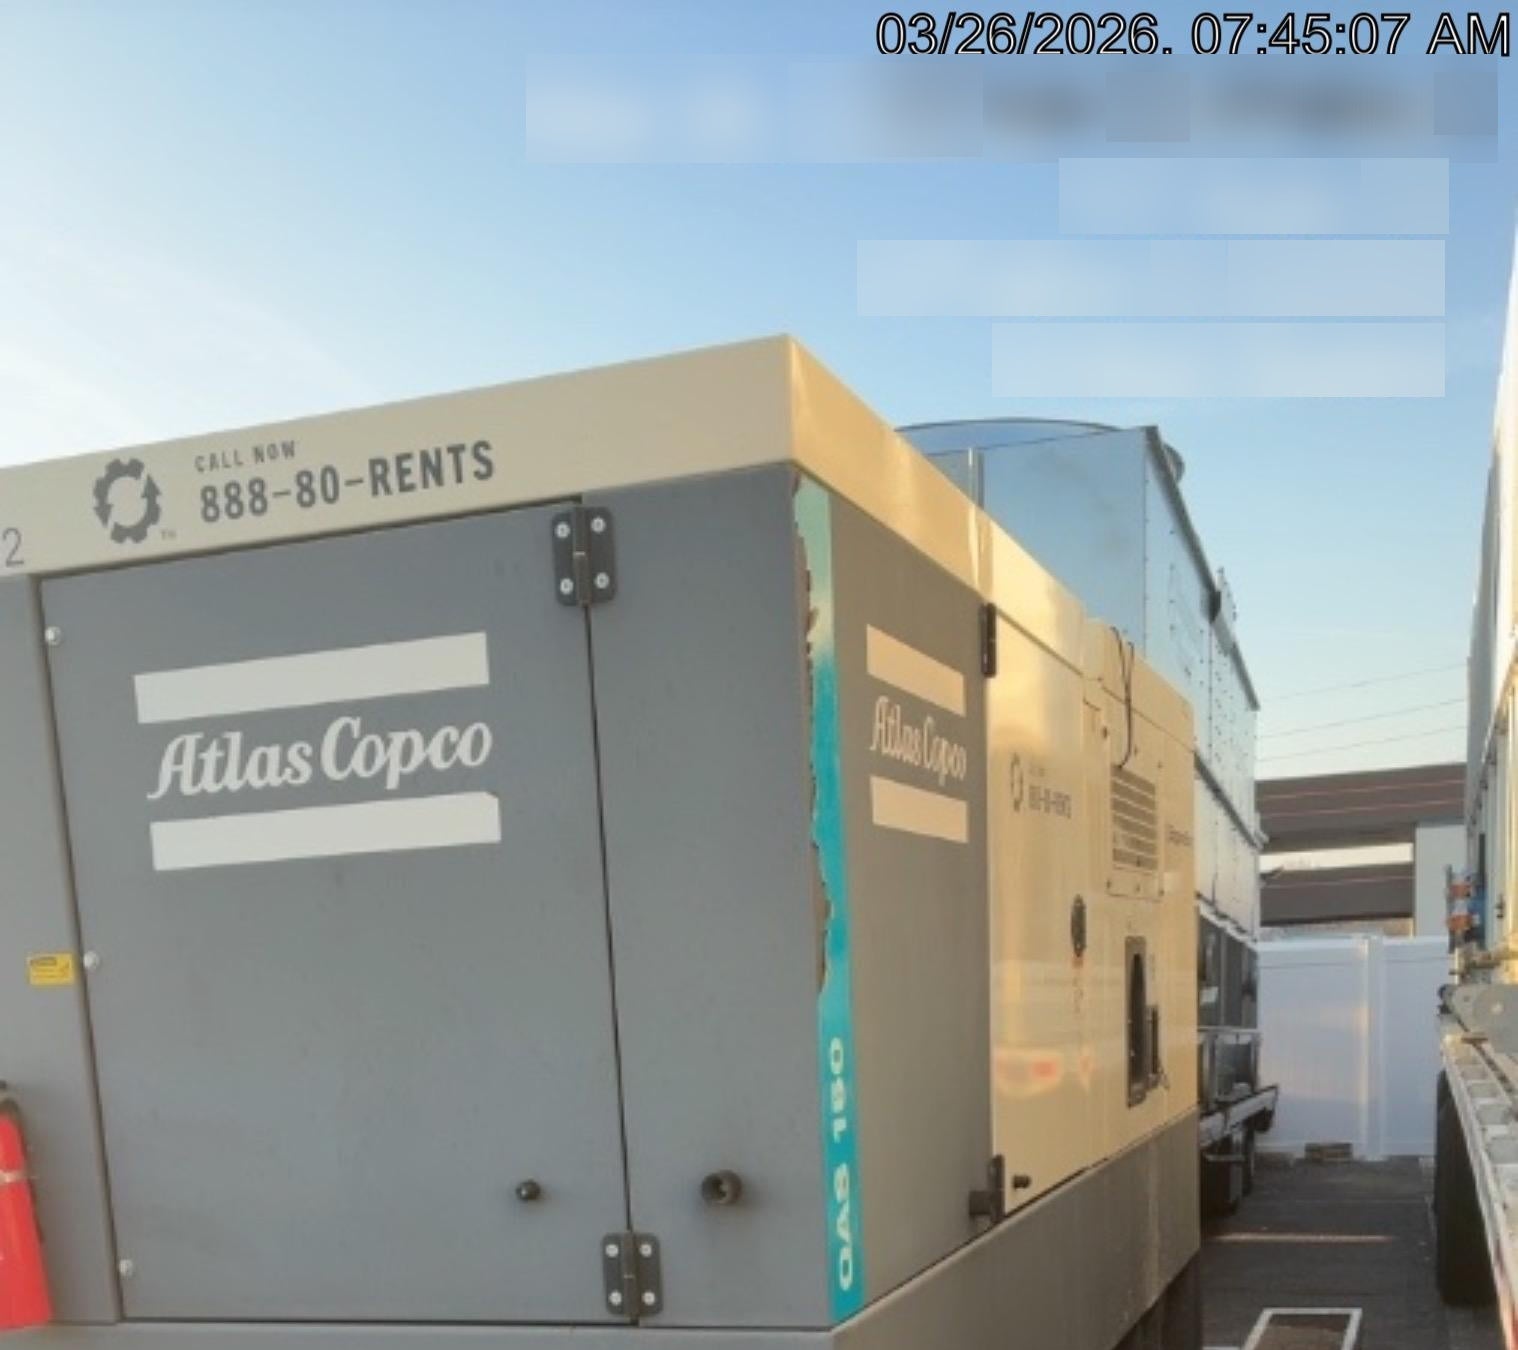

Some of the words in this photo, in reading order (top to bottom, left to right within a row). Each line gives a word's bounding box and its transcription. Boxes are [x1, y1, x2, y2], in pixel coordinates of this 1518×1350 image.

[194, 449, 244, 473] CALL
[252, 439, 296, 465] NOW
[200, 440, 495, 523] 888-80-RENTS
[147, 731, 313, 799] Atlas
[320, 716, 493, 790] Copco
[869, 695, 921, 767] Atlas
